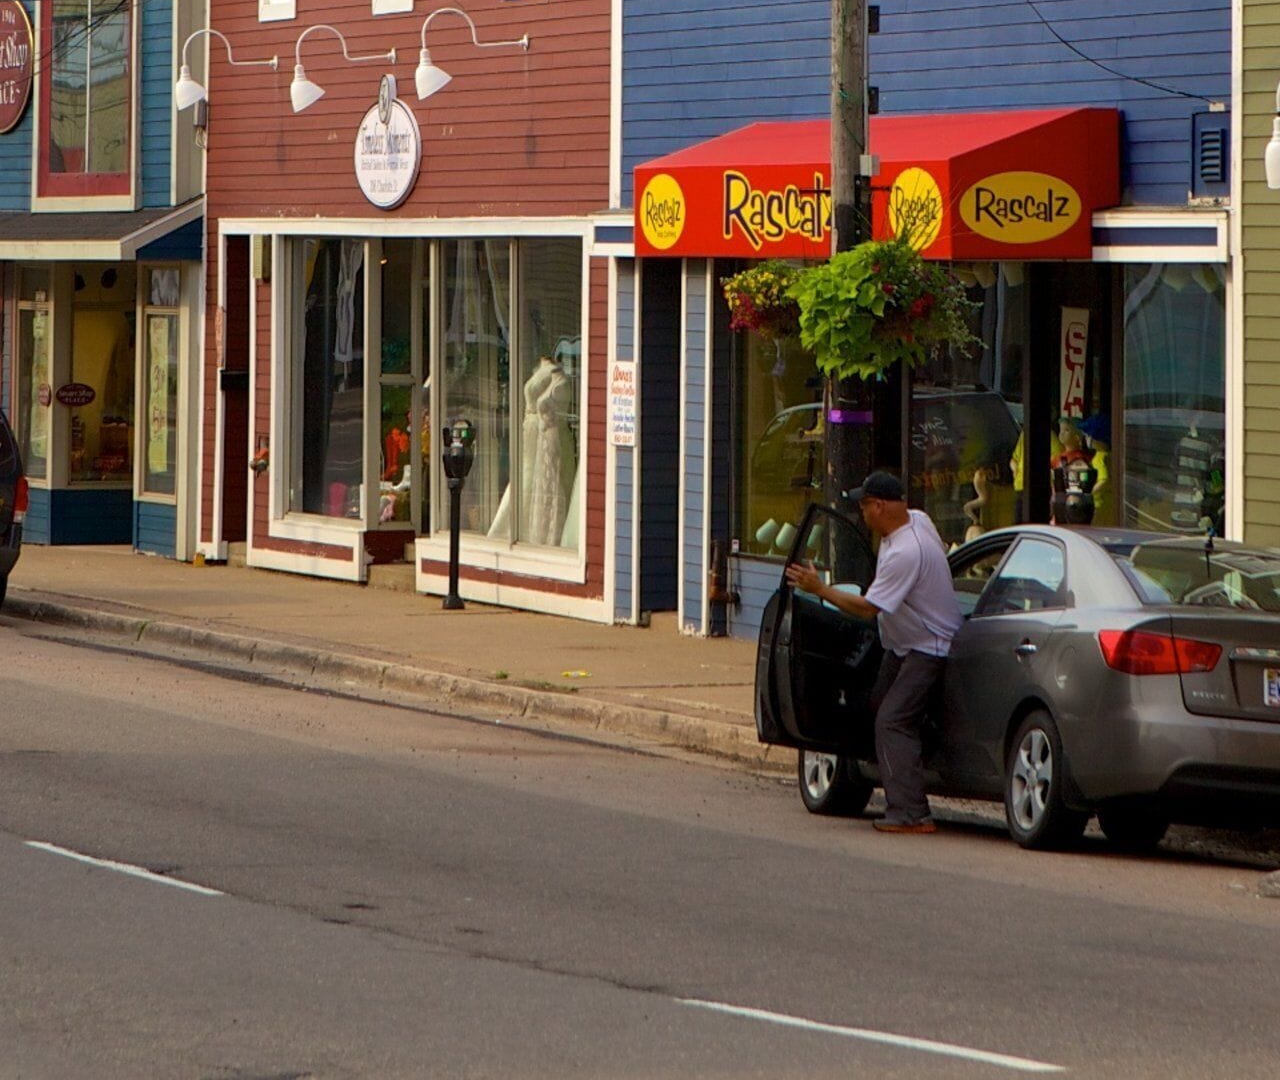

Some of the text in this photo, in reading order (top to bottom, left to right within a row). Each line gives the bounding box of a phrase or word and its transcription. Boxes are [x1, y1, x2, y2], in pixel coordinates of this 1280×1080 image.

[4, 31, 29, 73] Shop
[645, 191, 681, 231] Rascalz
[975, 186, 1070, 228] Rascalz
